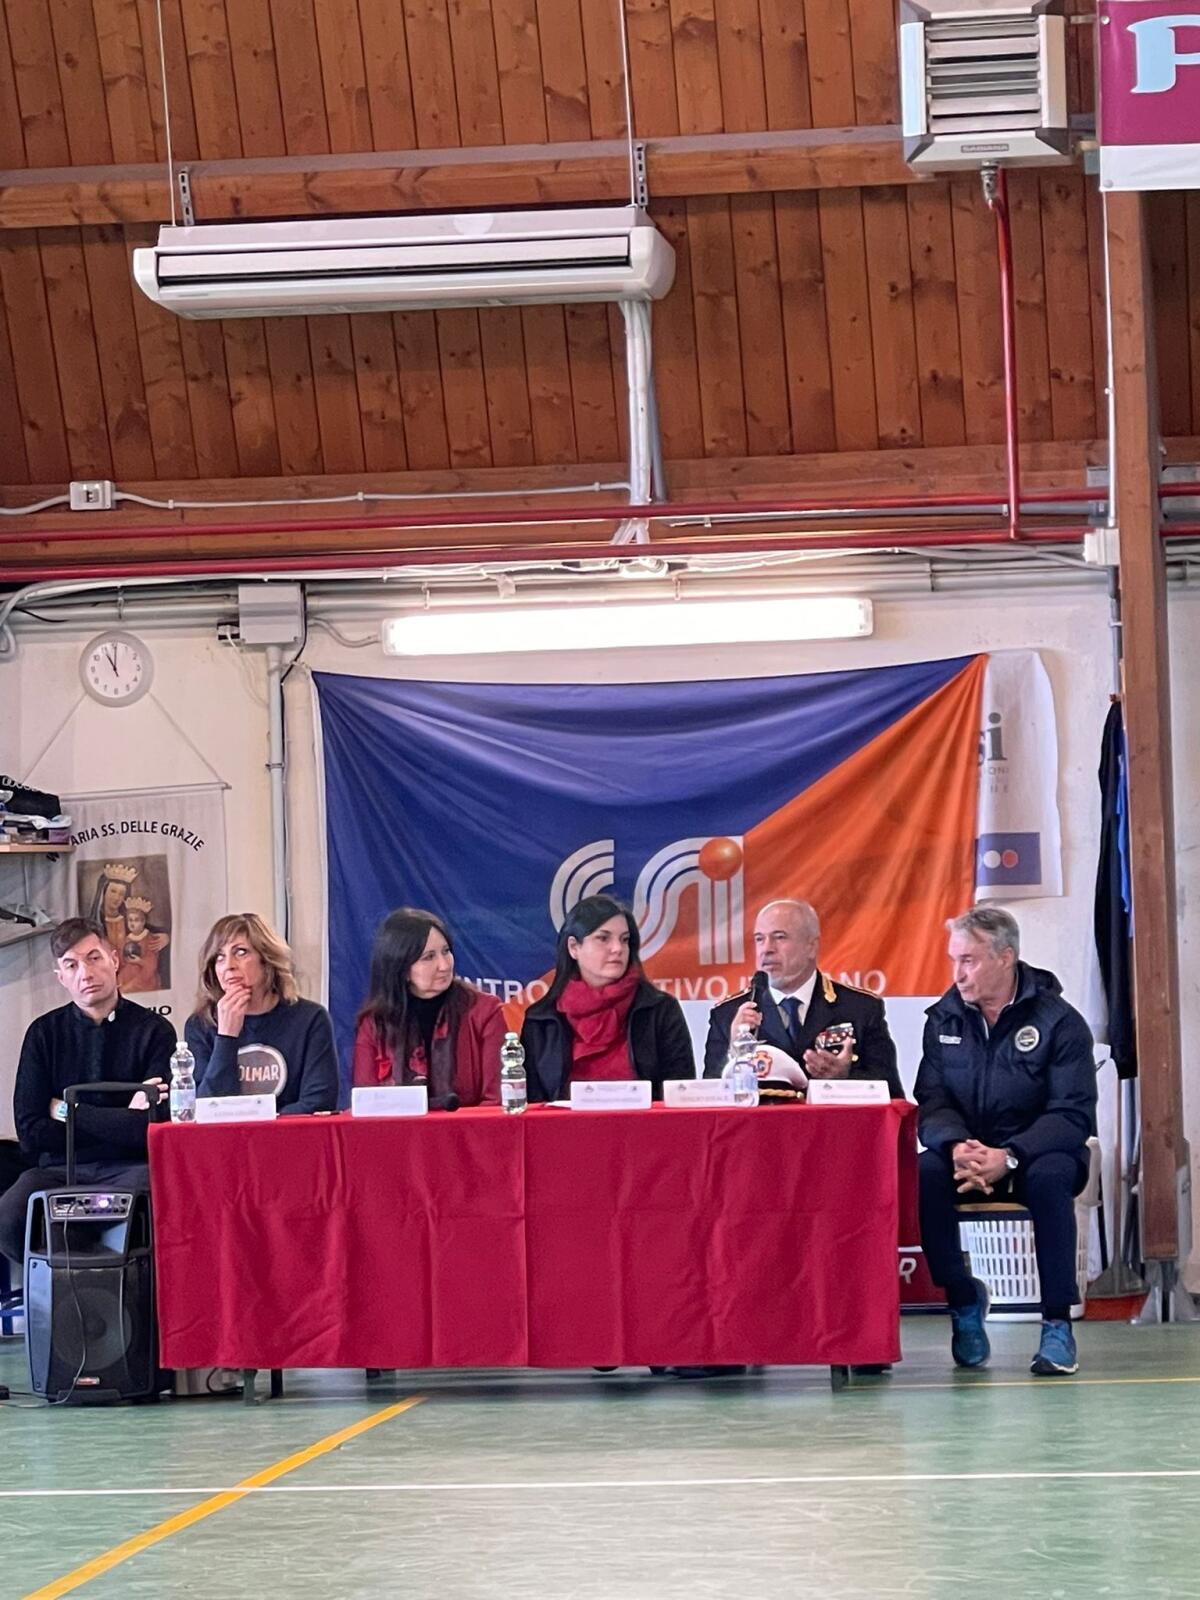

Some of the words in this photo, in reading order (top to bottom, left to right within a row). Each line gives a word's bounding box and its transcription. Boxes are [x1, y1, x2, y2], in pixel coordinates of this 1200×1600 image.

[101, 823, 119, 837] SS.
[121, 820, 158, 834] DELLE
[160, 822, 205, 851] GRAZIE
